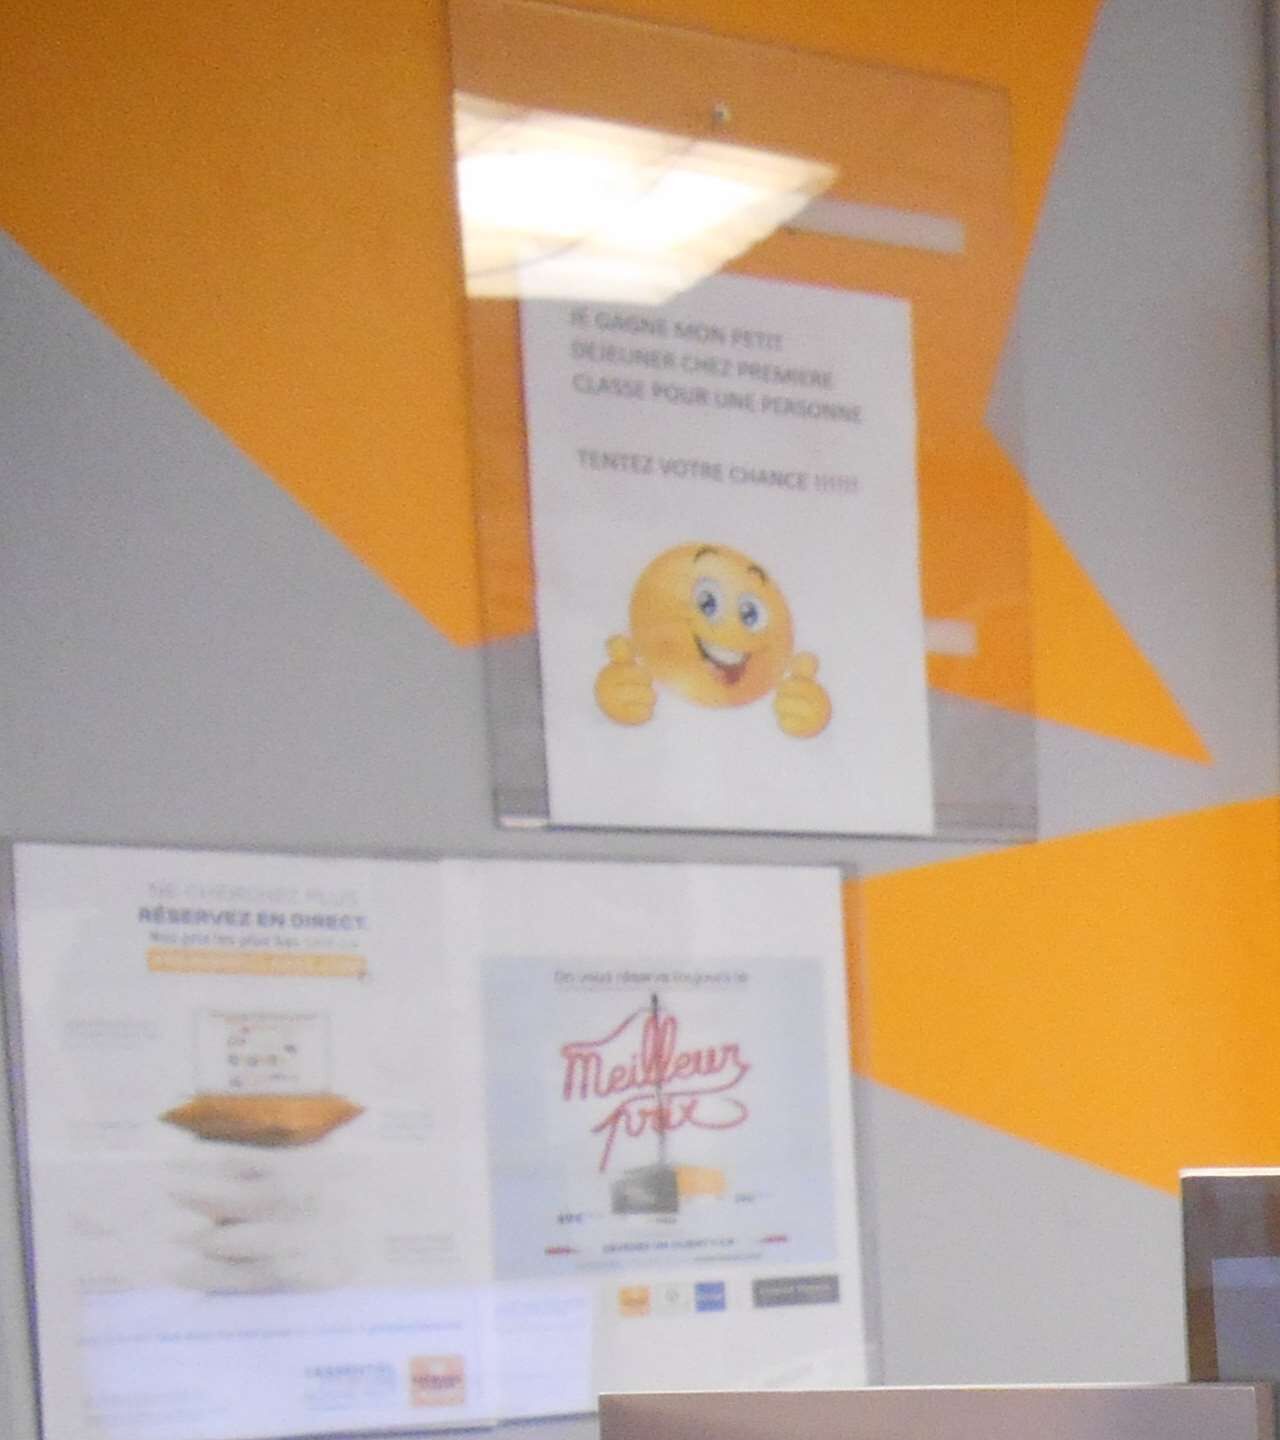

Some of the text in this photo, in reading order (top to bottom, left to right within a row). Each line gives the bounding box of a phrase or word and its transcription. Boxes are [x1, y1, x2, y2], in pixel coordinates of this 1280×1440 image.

[594, 311, 667, 338] GAGNE
[673, 320, 726, 346] MON
[731, 329, 783, 351] PETIT
[681, 355, 732, 378] CHEZ
[572, 373, 862, 424] CLASSE POUR UNE PERSONNE
[577, 449, 653, 475] TENTEZ
[658, 457, 723, 482] VOTRE
[729, 466, 808, 491] CHANCE
[256, 911, 285, 928] EN
[560, 1010, 751, 1100] Meilleur
[592, 1097, 748, 1173] prix
